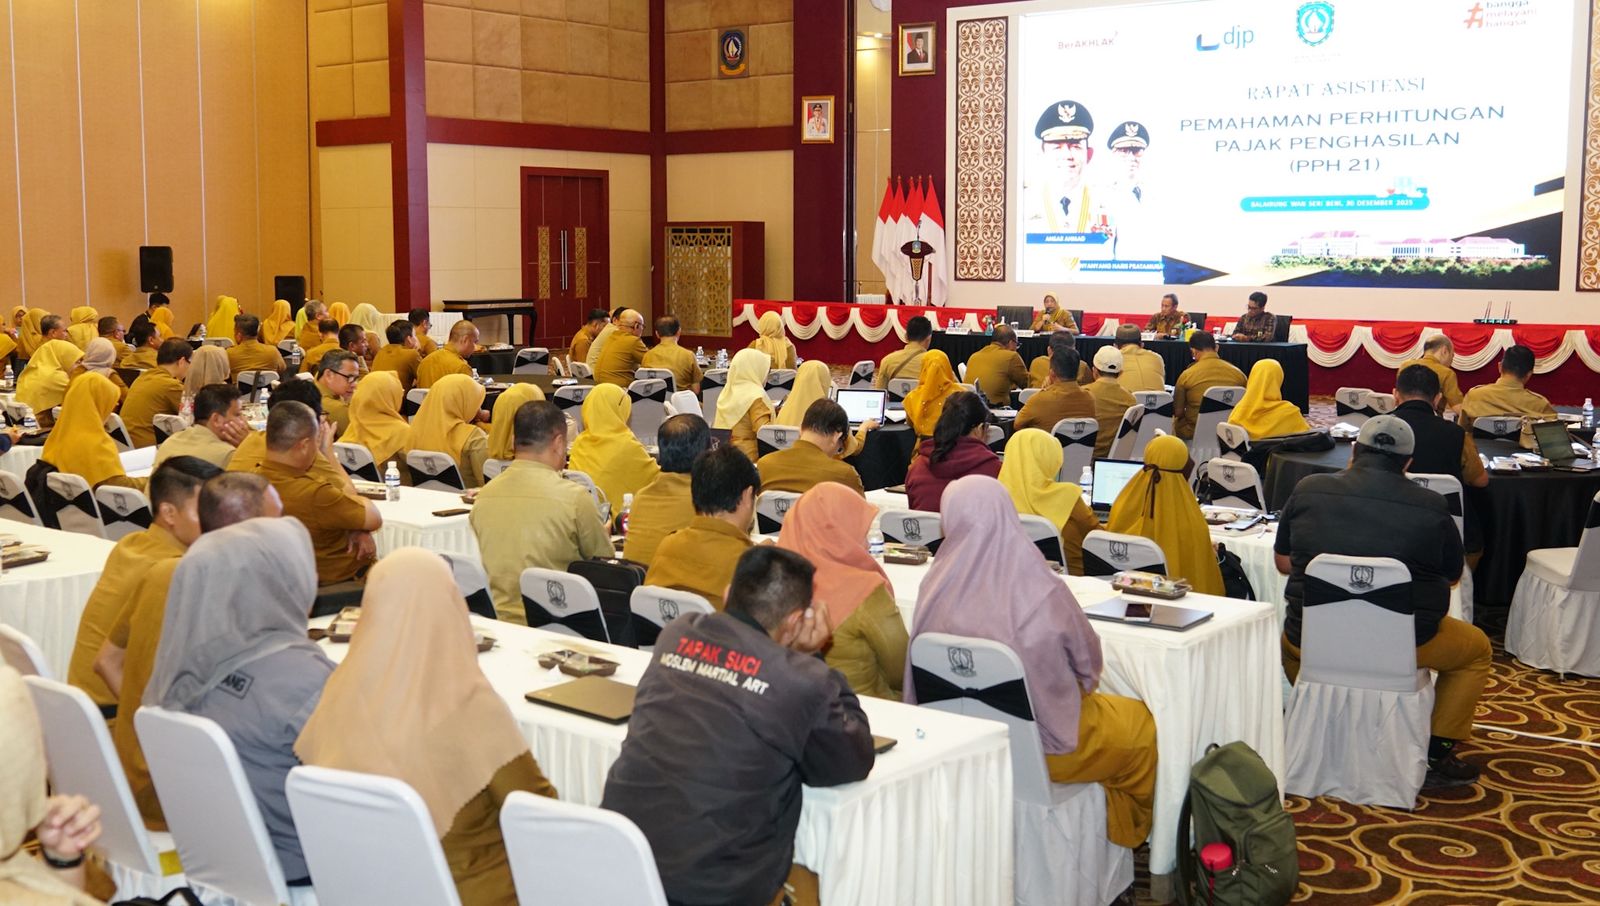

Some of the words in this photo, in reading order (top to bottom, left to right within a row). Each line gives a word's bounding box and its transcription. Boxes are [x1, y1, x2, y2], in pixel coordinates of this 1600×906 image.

[1057, 38, 1115, 50] BerAKHLAK
[1223, 25, 1254, 48] djp
[1247, 83, 1315, 101] RAPAT
[1321, 77, 1426, 97] ASISTENSI
[1180, 113, 1322, 131] PEMAHAMAN
[1329, 105, 1505, 126] PERHITUNGAN
[1215, 138, 1282, 152] PAJAK
[1289, 132, 1460, 150] PENGHASILAN
[1289, 159, 1341, 173] (PPH
[1348, 157, 1380, 172] 21)
[676, 637, 722, 664] TAPAK
[724, 650, 762, 676] SUCI
[221, 673, 247, 692] ANG
[659, 652, 698, 669] MOSLEM
[697, 661, 739, 687] MARTIAL
[742, 676, 770, 695] ART
